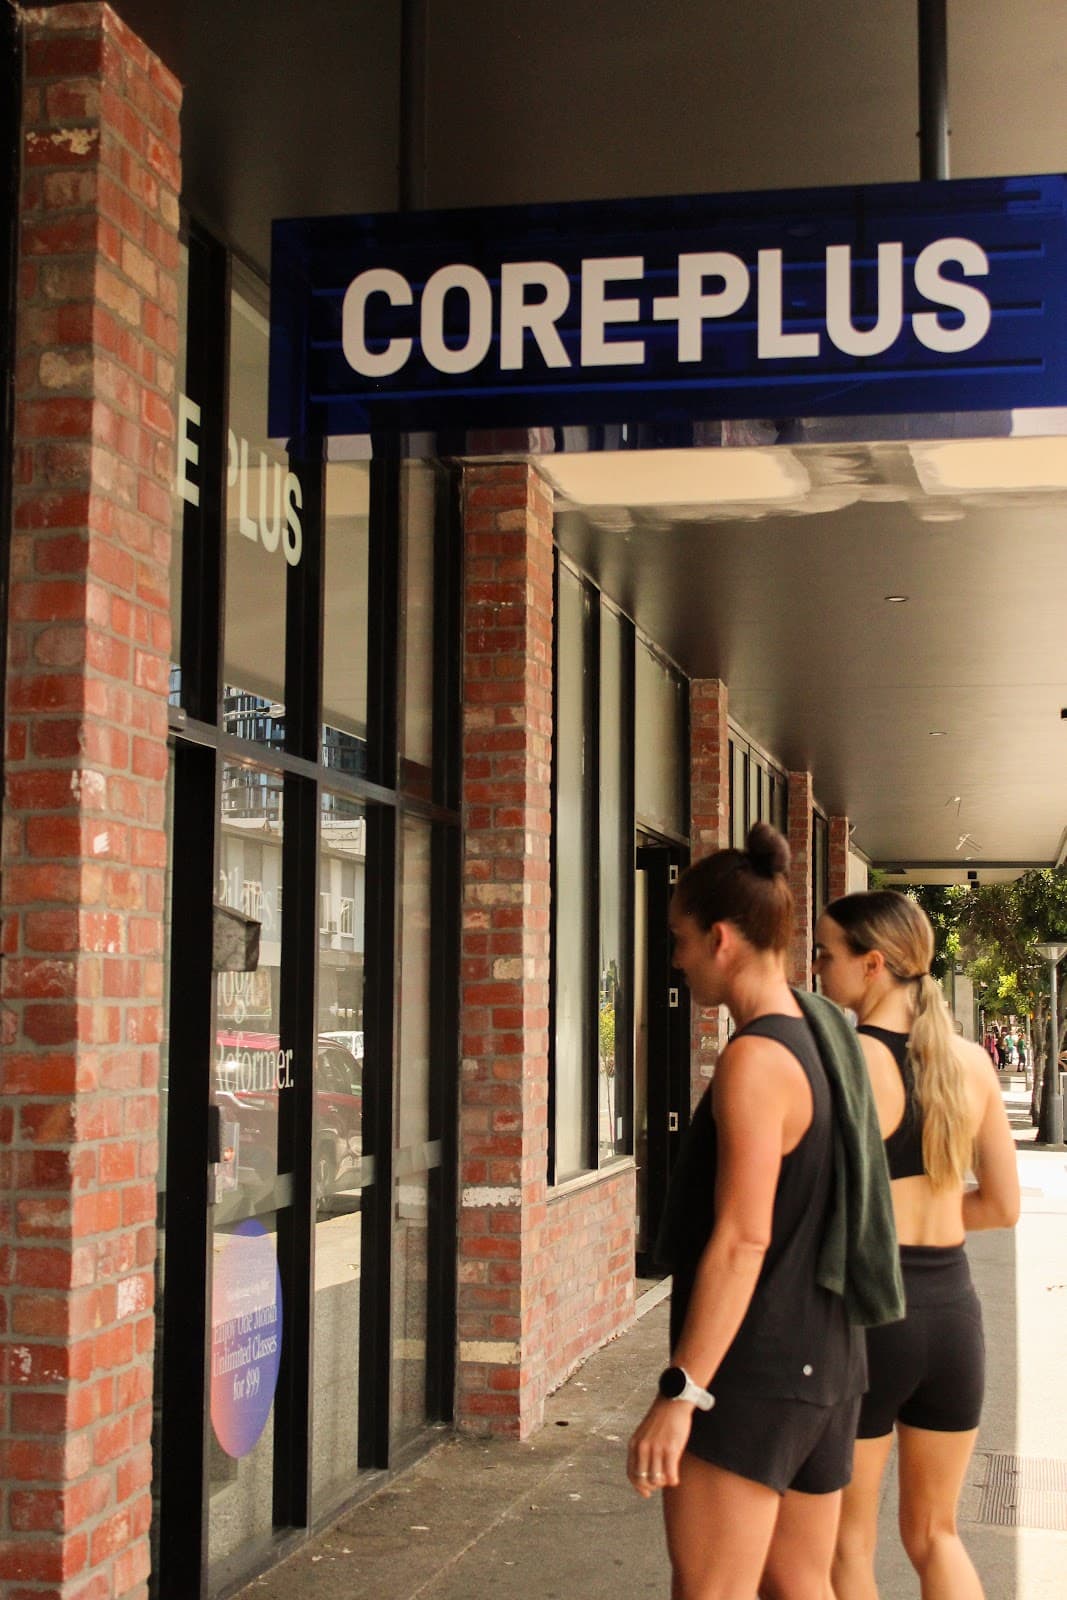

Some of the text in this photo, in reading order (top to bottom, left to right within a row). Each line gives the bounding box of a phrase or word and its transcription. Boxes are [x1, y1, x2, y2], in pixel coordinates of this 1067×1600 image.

[213, 1333, 278, 1378] Unlimited Classes
[233, 1374, 245, 1401] for
